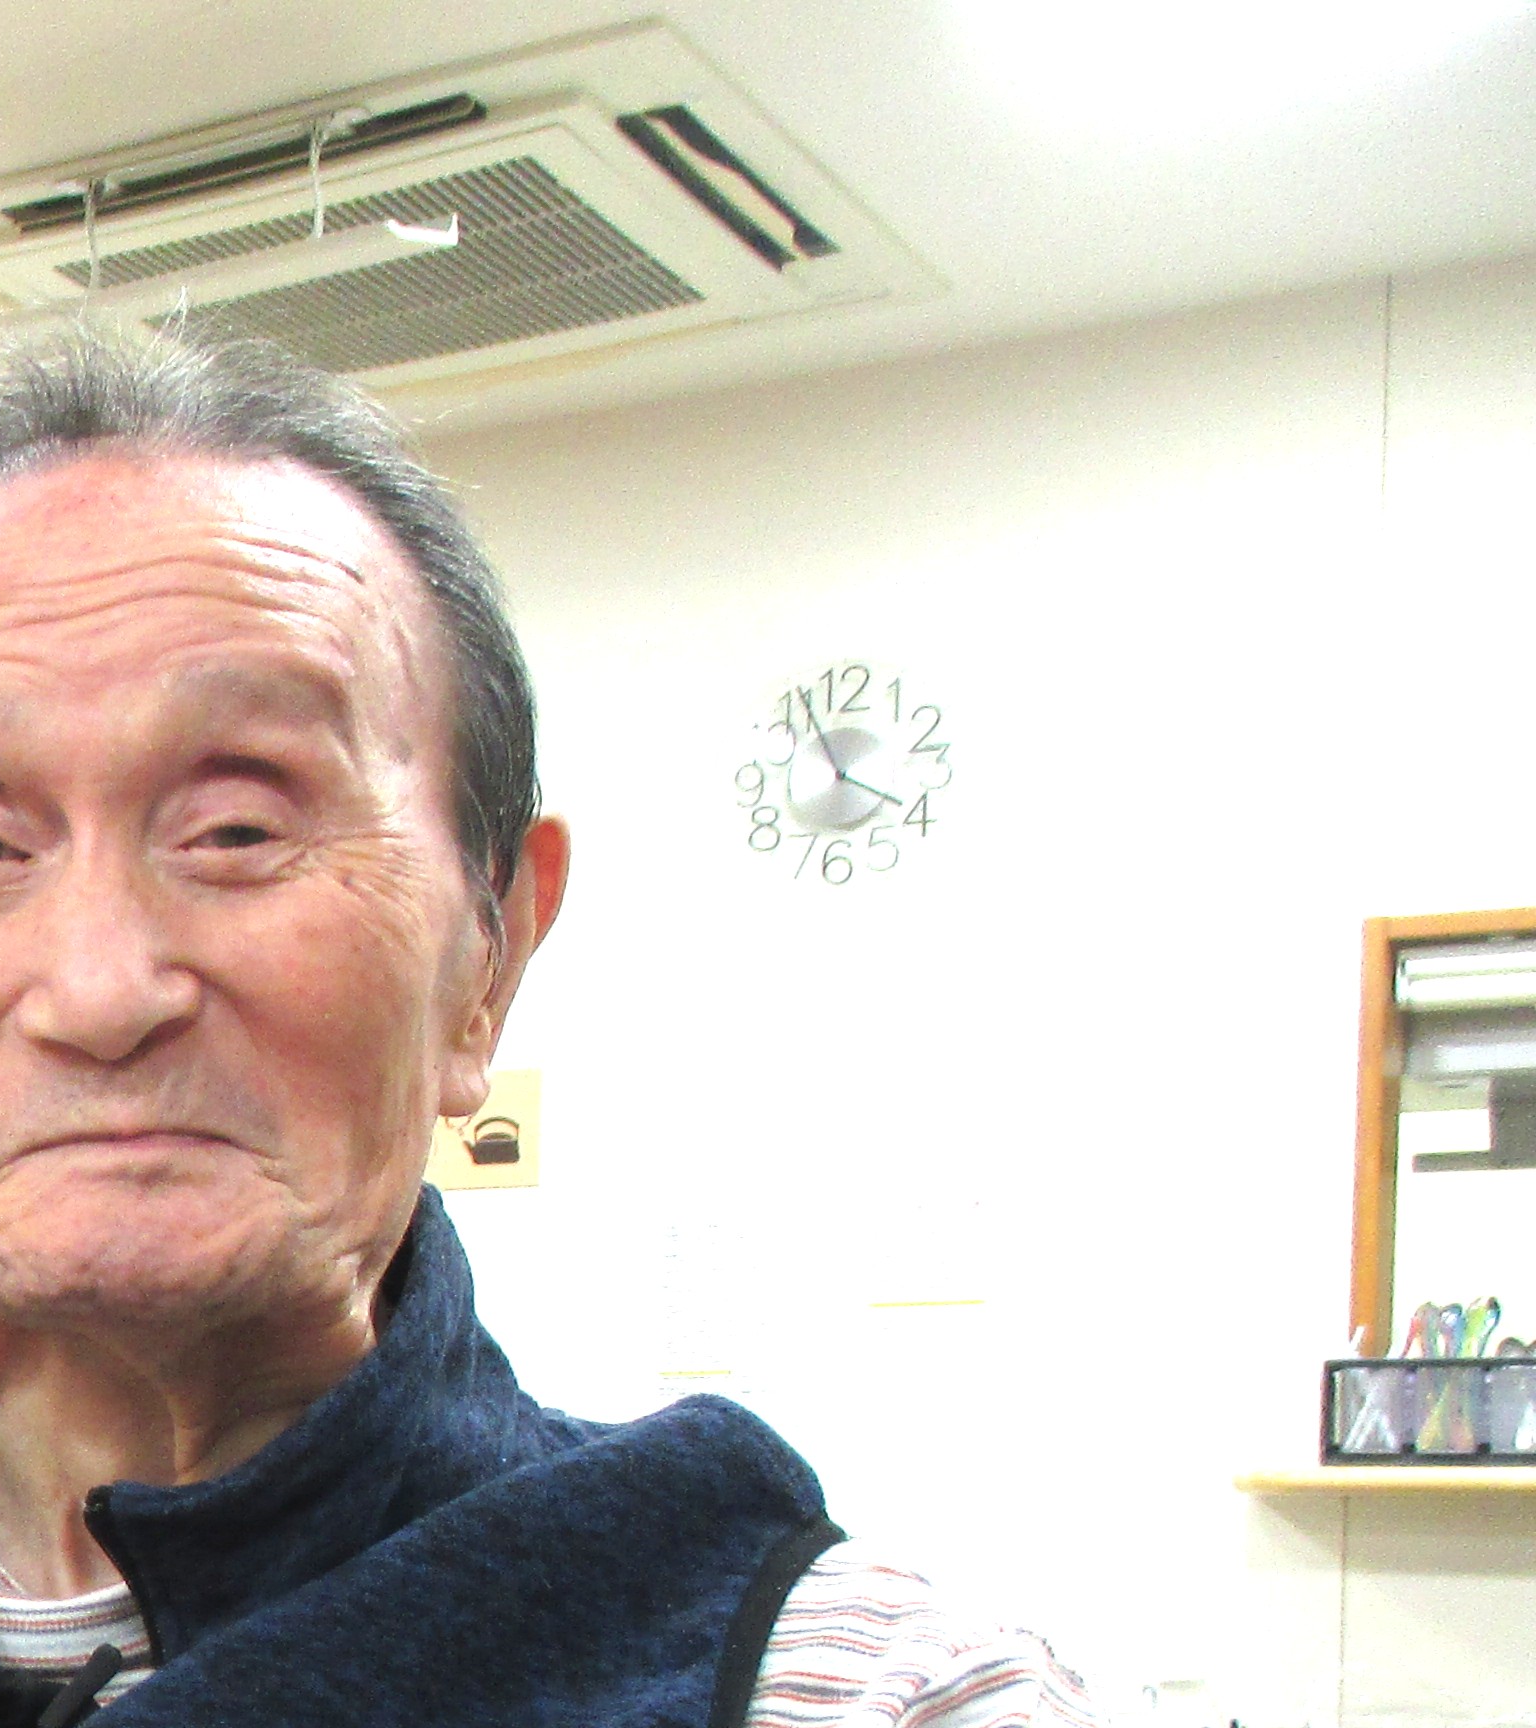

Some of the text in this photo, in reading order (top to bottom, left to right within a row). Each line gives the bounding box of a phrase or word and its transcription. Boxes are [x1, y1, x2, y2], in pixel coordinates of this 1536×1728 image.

[819, 664, 871, 714] 12
[887, 677, 901, 723] 1
[908, 704, 943, 754] 2
[734, 760, 765, 808] 9
[748, 805, 781, 852] 8
[902, 790, 938, 838] 4
[788, 832, 820, 880] 7
[822, 839, 853, 886] 6
[866, 824, 900, 872] 5
